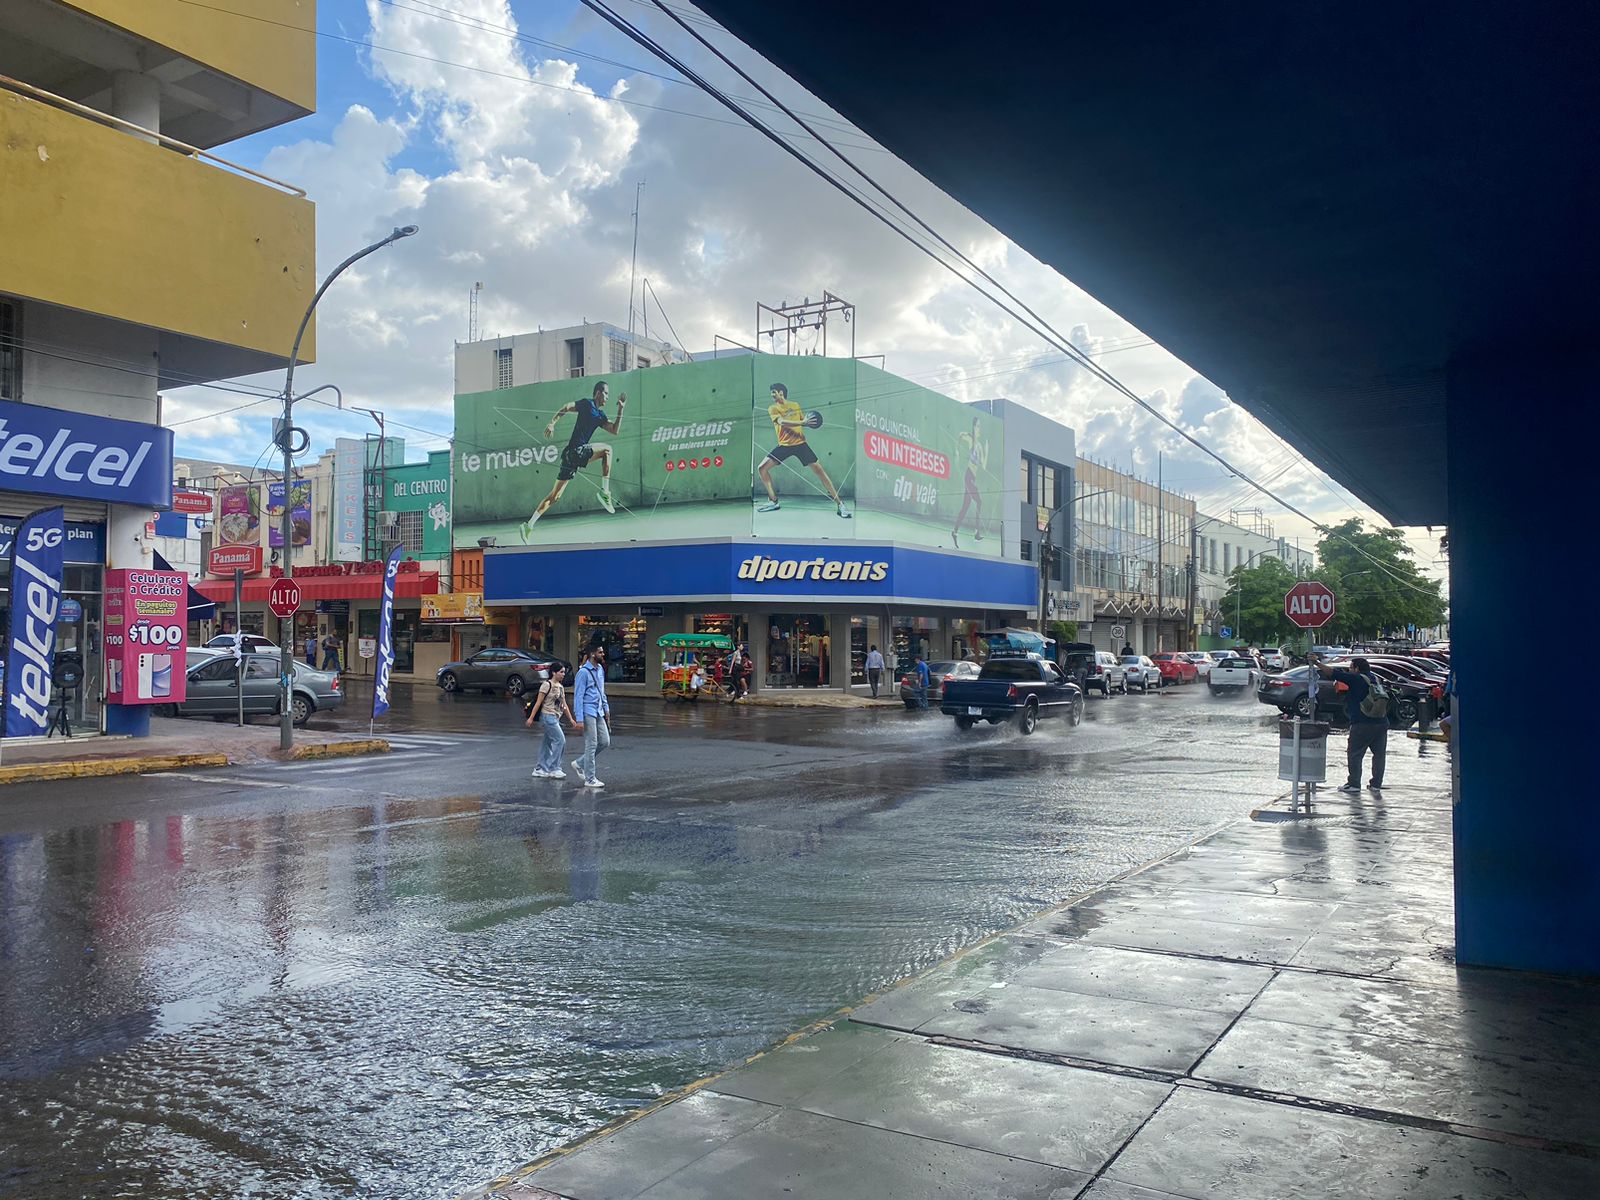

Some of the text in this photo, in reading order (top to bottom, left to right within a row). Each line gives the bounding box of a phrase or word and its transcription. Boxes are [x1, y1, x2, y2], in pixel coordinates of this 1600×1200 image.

[651, 421, 732, 443] dportenis
[855, 408, 920, 442] PAGO QUINCENAL
[668, 443, 679, 451] Las
[705, 438, 728, 448] marcas
[461, 444, 558, 473] te mueve
[870, 435, 945, 475] SIN INTERESES
[394, 482, 407, 497] DEL
[410, 479, 447, 495] CENTRO
[894, 475, 937, 505] dp vale
[173, 495, 208, 506] Panamá
[26, 527, 62, 551] 5G
[68, 528, 93, 540] plan
[213, 550, 251, 564] Panamá
[130, 573, 182, 584] Celulares
[737, 555, 889, 582] dportenis
[130, 586, 137, 594] a
[140, 584, 182, 596] Crédito
[271, 589, 298, 605] ALTO
[1289, 594, 1332, 614] ALTO
[11, 555, 60, 727] telcel
[129, 624, 182, 645] $100
